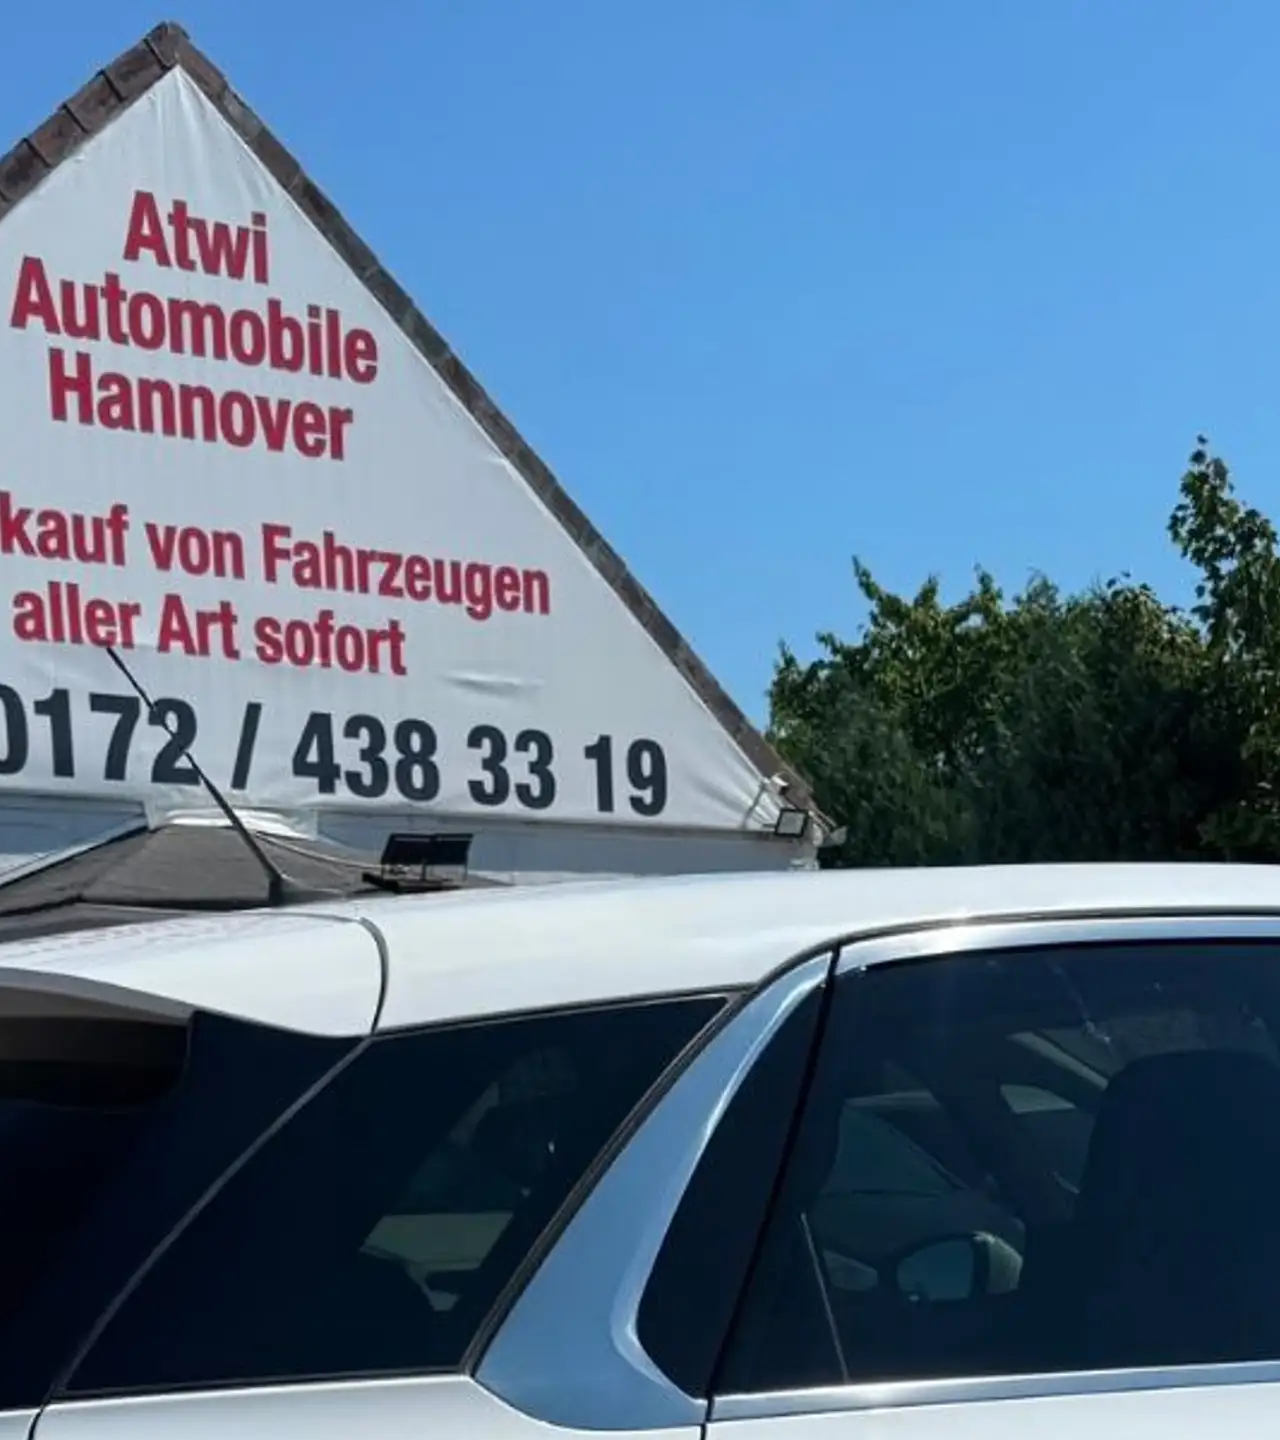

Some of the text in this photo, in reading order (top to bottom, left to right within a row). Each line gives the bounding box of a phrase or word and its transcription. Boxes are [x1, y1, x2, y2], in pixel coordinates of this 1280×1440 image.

[124, 191, 269, 283] Atwi
[11, 257, 378, 383] Automobile
[48, 349, 353, 460] Hannover
[146, 522, 245, 578] von
[262, 524, 550, 620] Fahrzeugen
[13, 582, 407, 676] aller Art sofort
[231, 702, 262, 790] /
[292, 711, 440, 803] 438
[467, 724, 557, 811] 33
[584, 735, 668, 818] 19
